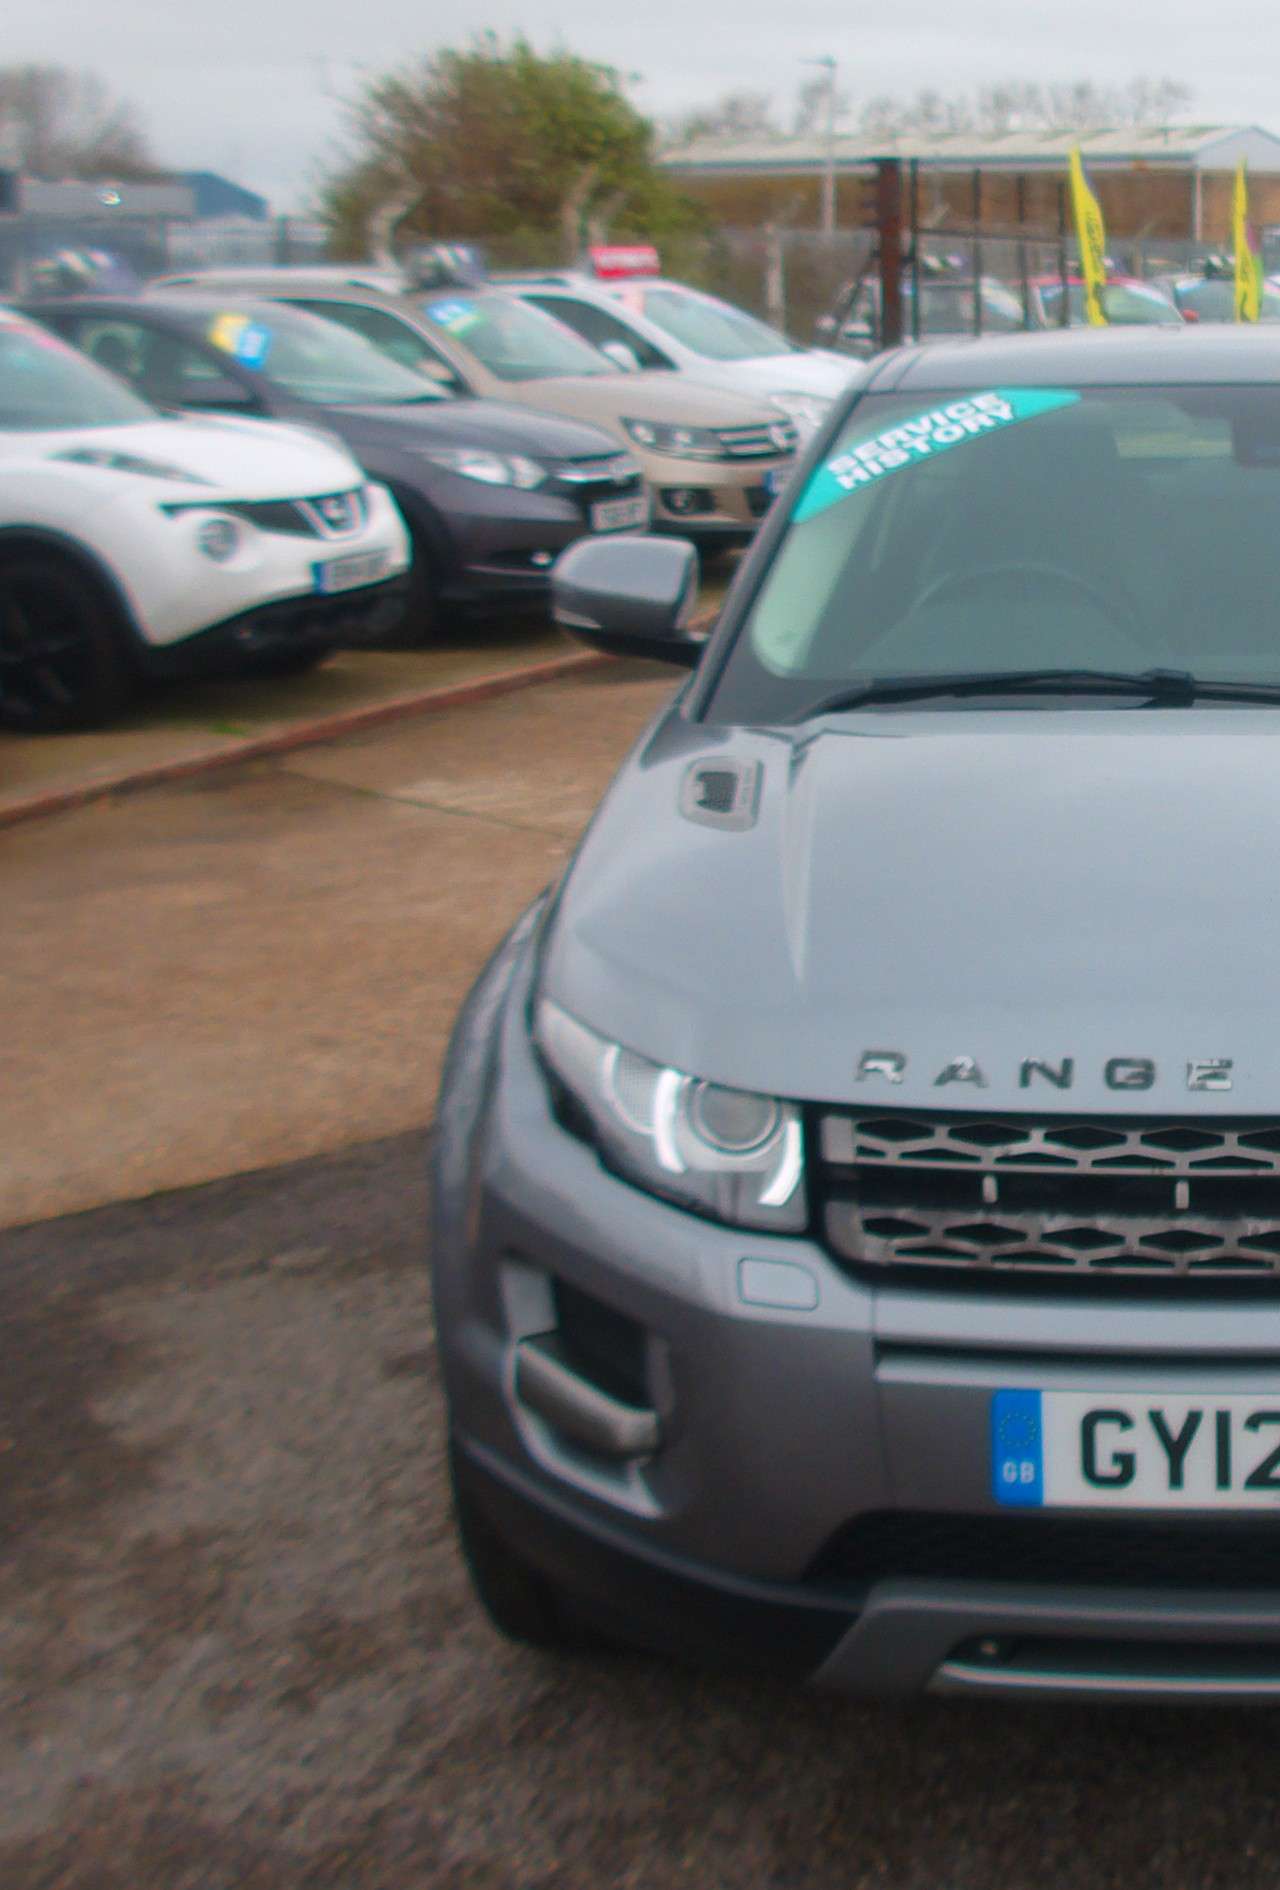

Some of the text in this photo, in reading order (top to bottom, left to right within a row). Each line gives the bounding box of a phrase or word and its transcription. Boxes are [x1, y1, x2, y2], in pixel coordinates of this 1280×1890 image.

[827, 392, 1003, 474] SERVICE
[836, 400, 1015, 490] HISTORY
[854, 1050, 1234, 1092] RANGE
[1002, 1462, 1036, 1485] GB
